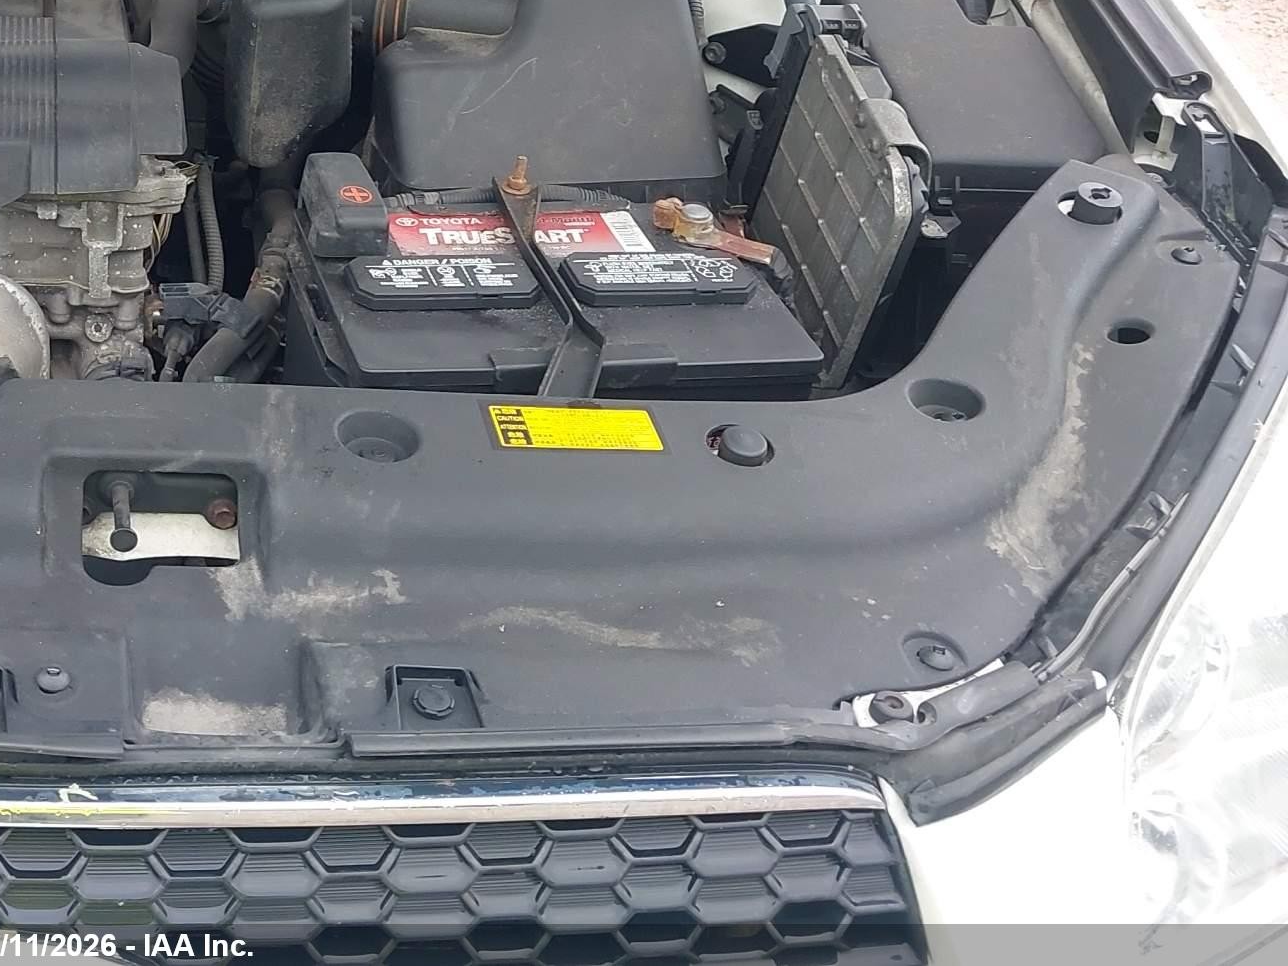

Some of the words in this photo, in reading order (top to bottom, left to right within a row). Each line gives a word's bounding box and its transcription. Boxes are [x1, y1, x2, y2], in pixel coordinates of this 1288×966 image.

[419, 217, 483, 226] TOYOTA
[419, 226, 585, 246] TRUESART
[393, 258, 440, 266] DANGER
[450, 257, 492, 265] POISON
